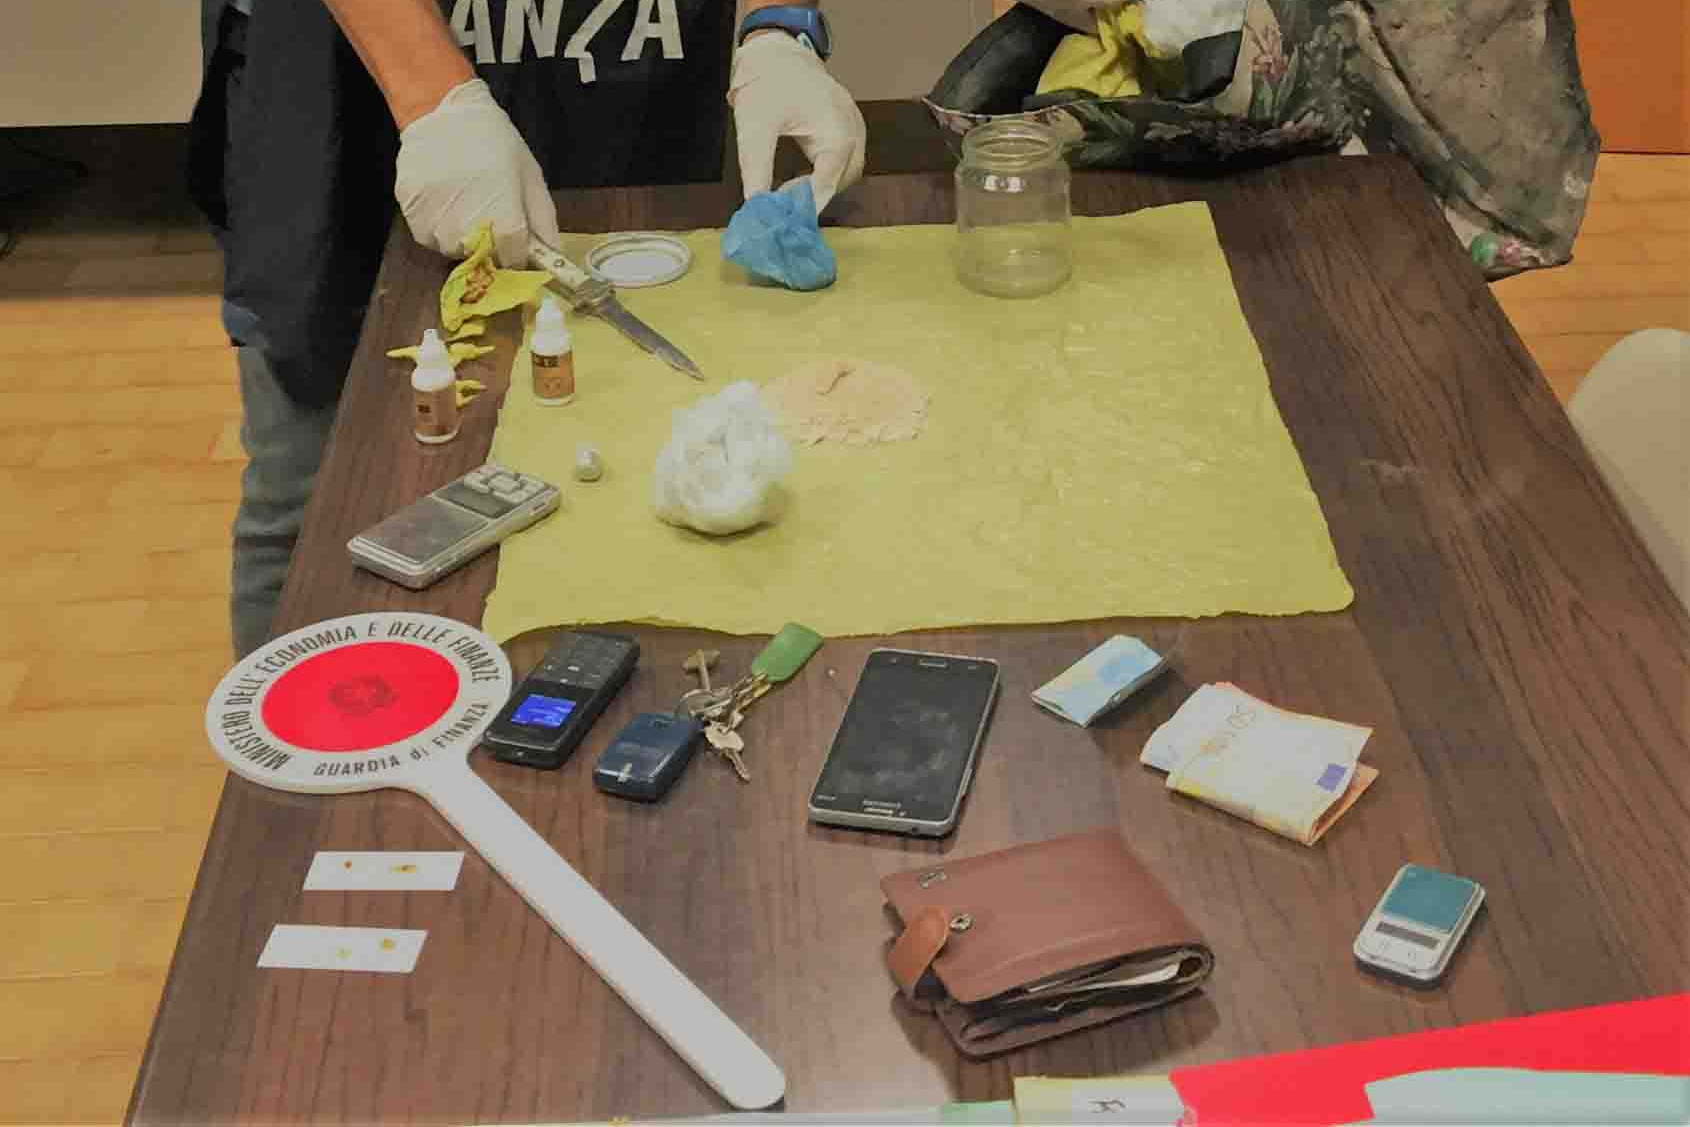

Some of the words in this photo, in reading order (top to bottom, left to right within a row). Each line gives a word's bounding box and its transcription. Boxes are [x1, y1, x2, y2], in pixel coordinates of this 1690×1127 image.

[254, 625, 358, 673] ECONOMIA
[367, 621, 377, 637] E
[387, 620, 454, 644] DELLE
[447, 636, 502, 682] FINANZE
[223, 711, 291, 770] MINISTERO
[313, 754, 400, 777] GUARDIA
[432, 702, 491, 748] FINANZA
